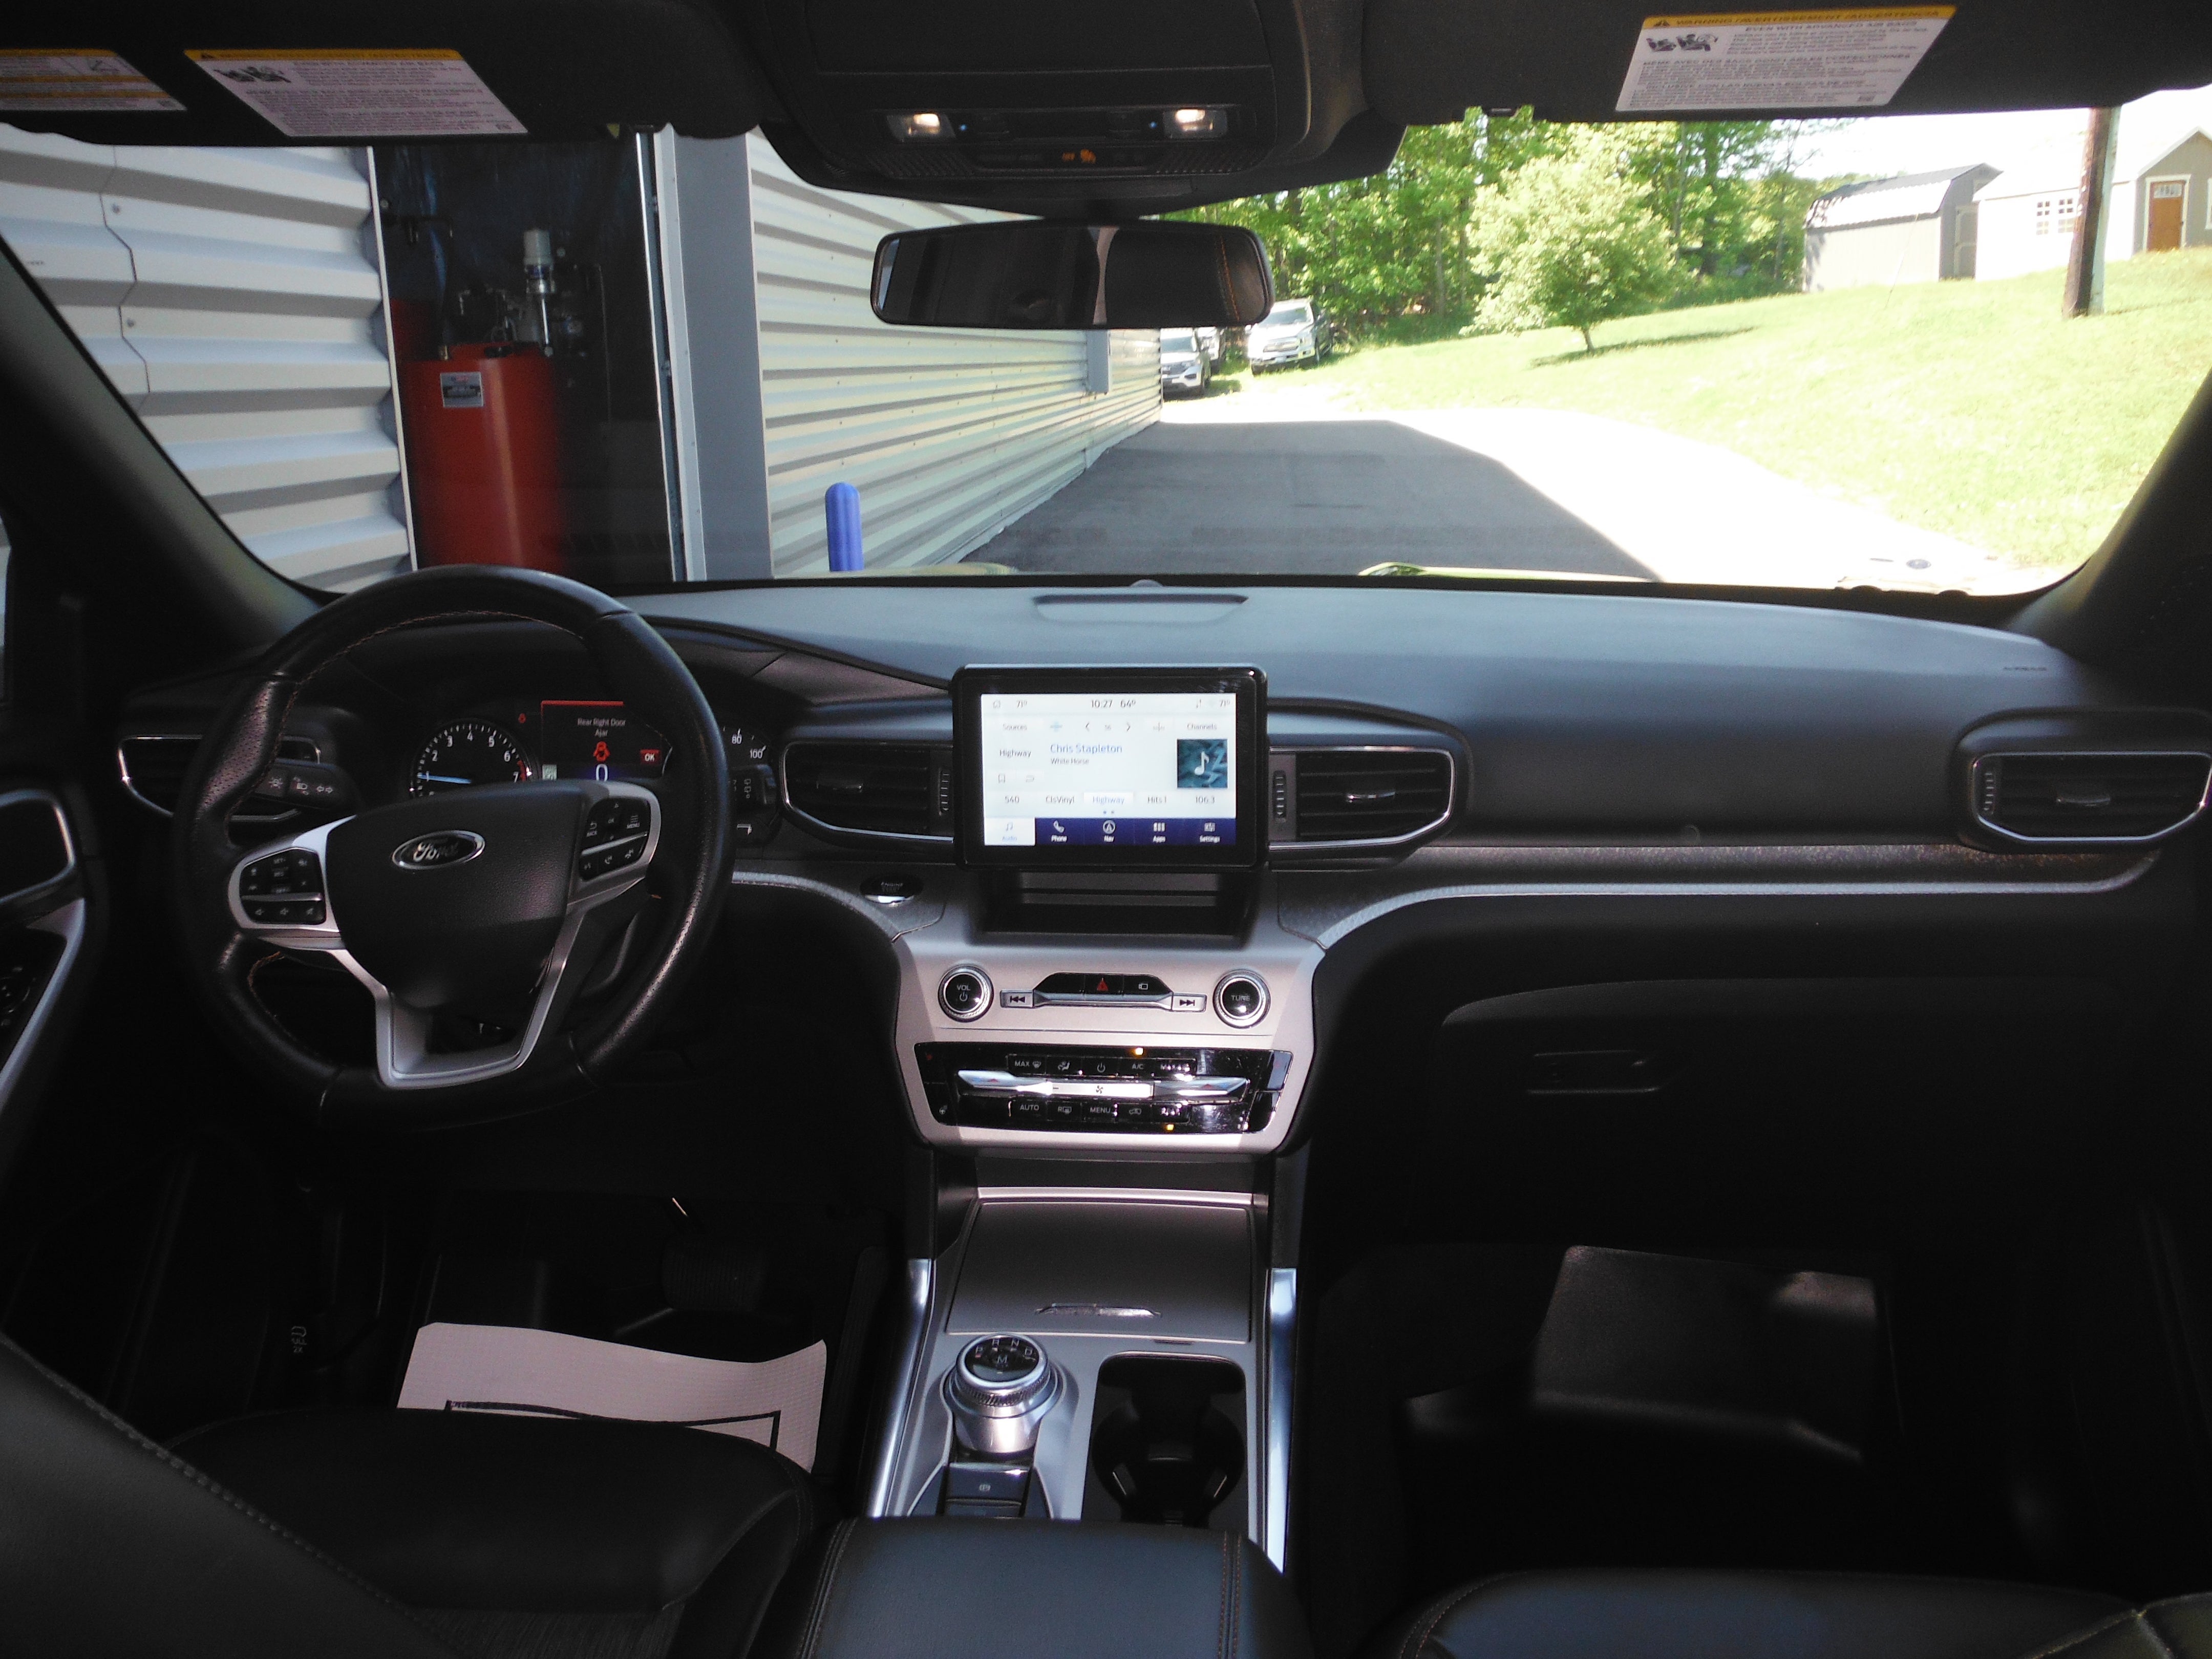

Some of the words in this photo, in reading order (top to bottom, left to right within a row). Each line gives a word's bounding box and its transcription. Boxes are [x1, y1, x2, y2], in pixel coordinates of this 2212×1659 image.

[1091, 699, 1113, 709] 10:27
[577, 717, 592, 727] Rear
[593, 717, 609, 728] Right
[610, 717, 626, 727] Door
[466, 731, 474, 741] 4
[594, 729, 608, 738] Ajar
[446, 735, 454, 748] 3
[488, 735, 495, 748] 5
[731, 734, 742, 745] 80
[749, 748, 763, 759] 100
[999, 749, 1032, 759] Highway
[1050, 743, 1074, 753] Chris
[1076, 743, 1122, 755] Stapleton
[431, 750, 438, 762] 2
[503, 750, 511, 762] 6
[644, 753, 655, 762] OK
[1092, 796, 1125, 805] Highway
[1199, 835, 1221, 843] Settings
[413, 841, 460, 863] Ford
[1011, 1338, 1020, 1347] N
[975, 1346, 984, 1354] P
[1024, 1346, 1034, 1356] D
[996, 1354, 1008, 1364] M
